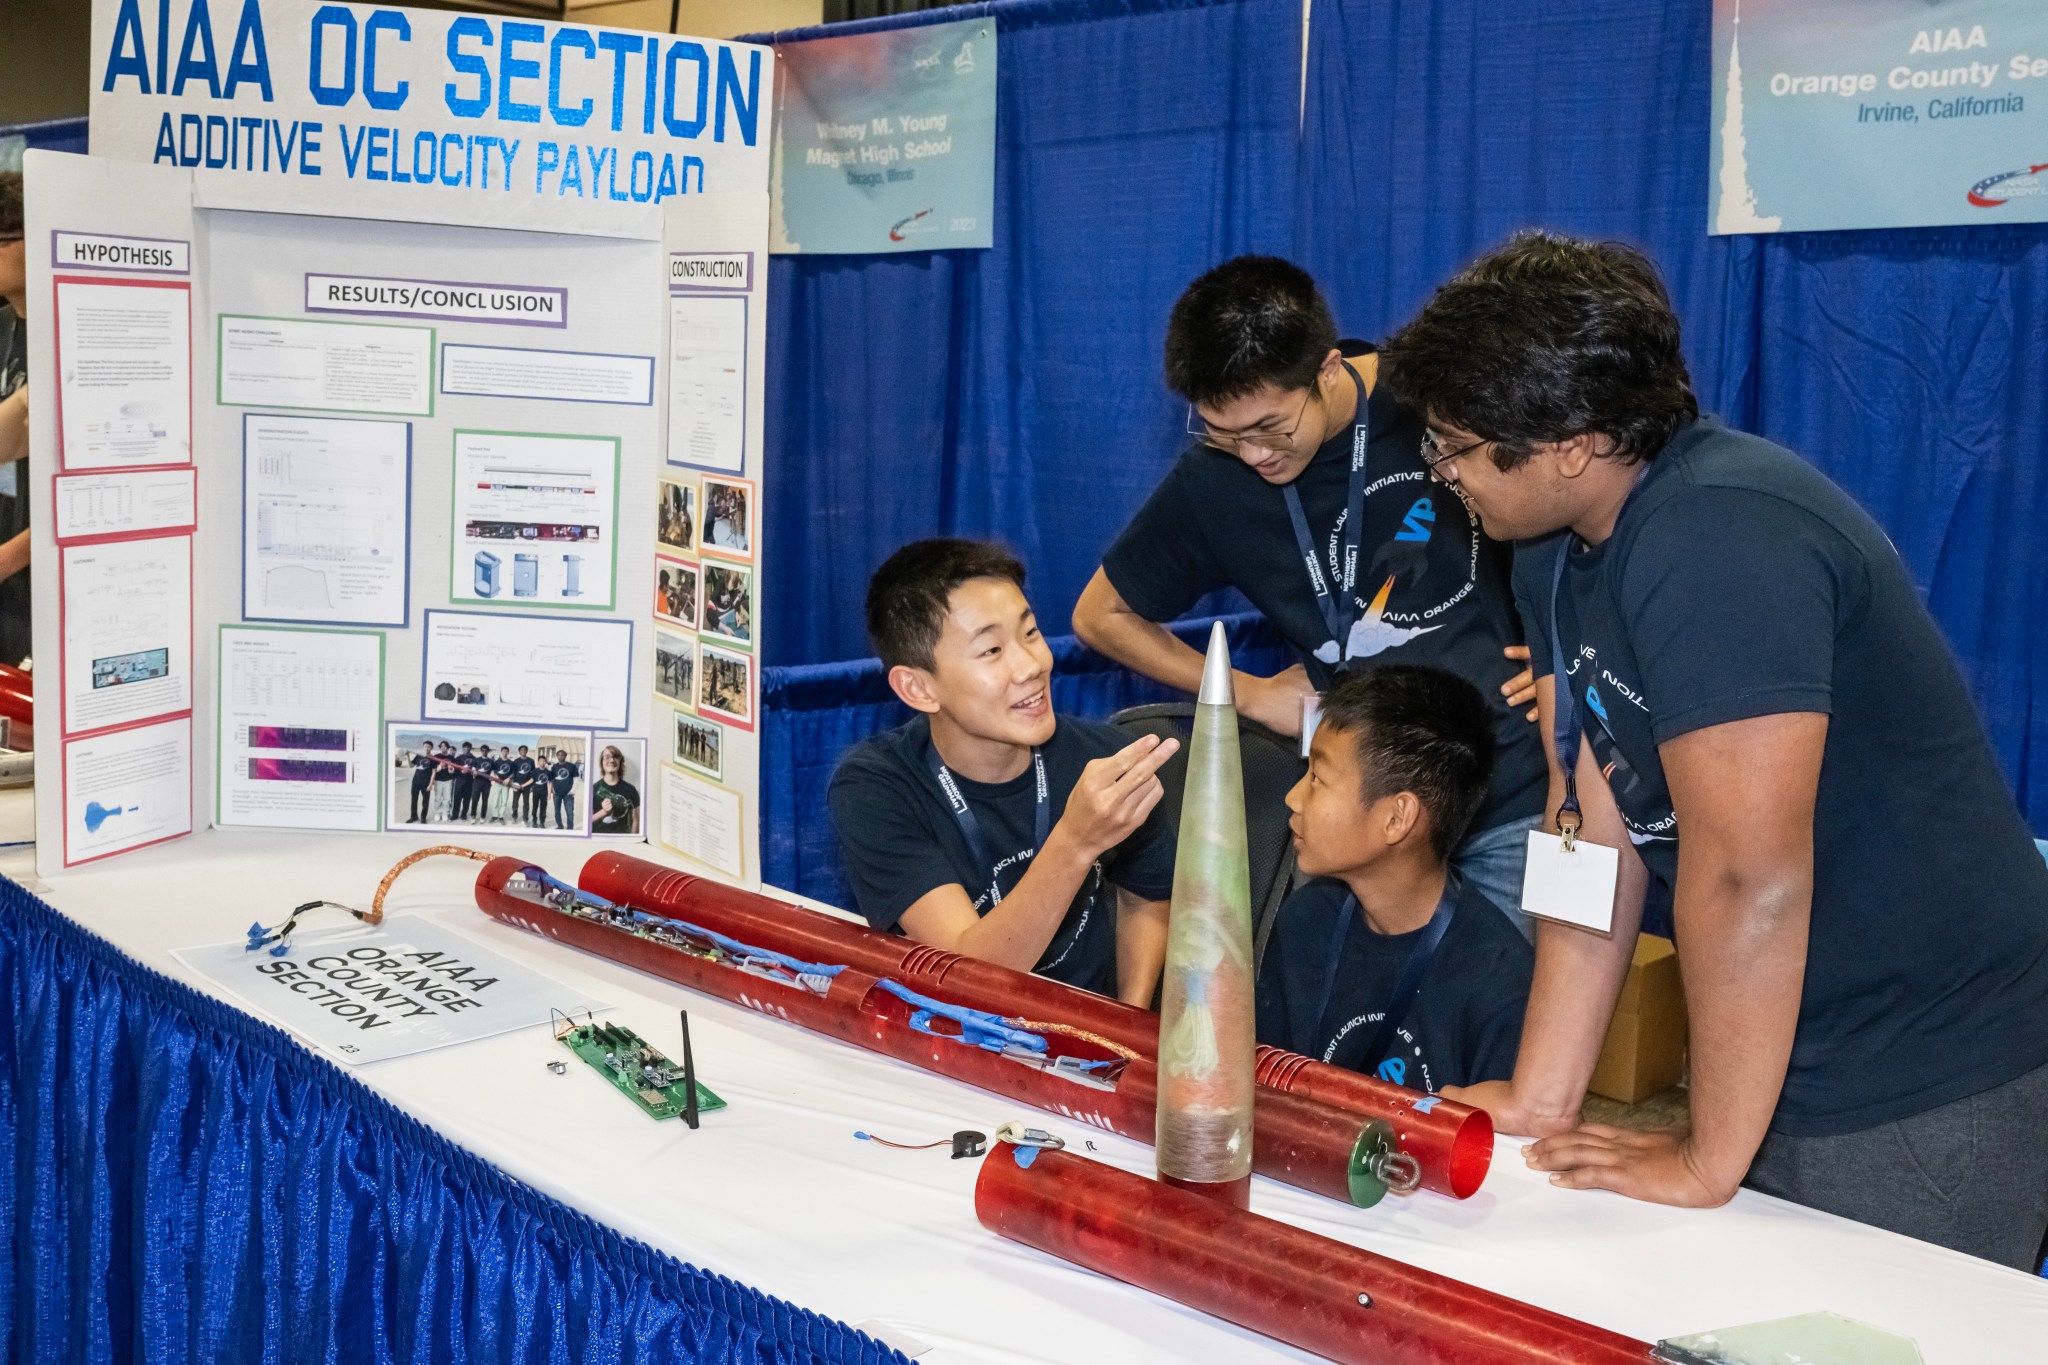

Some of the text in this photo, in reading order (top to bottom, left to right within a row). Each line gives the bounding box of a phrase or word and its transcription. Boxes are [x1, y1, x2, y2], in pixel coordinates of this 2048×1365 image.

[1909, 25, 1986, 54] AIAA
[102, 0, 761, 146] AIAA OC SECTION
[1770, 73, 1877, 96] Orange
[1888, 61, 1999, 91] County
[871, 117, 893, 135] M.
[899, 114, 947, 133] Young
[1858, 93, 2024, 123] Irvine, California
[153, 112, 705, 204] ADDITIVE VELOCITY PAYLOAD
[860, 144, 900, 165] High
[904, 136, 951, 160] School
[74, 243, 173, 266] HYPOTHESIS
[672, 261, 743, 278] CONSTRUCTION
[1352, 435, 1360, 471] NORTHROP
[1358, 430, 1366, 467] GRUMMAN
[1328, 533, 1343, 582] STUDENT
[1363, 471, 1425, 496] INITIATIVE
[1305, 556, 1321, 591] GRUMMAN
[1309, 549, 1325, 585] NORTHROP
[1349, 550, 1357, 587] GRUMMAN
[1424, 582, 1474, 619] ORANGE
[1471, 530, 1480, 581] COUNTY
[938, 773, 960, 809] GRUMMAN
[940, 765, 963, 801] NORTHROP
[1039, 759, 1048, 798] GRUMMAN
[307, 957, 438, 1018] COUNTY
[347, 948, 485, 1013] ORANGE
[402, 952, 498, 992] AIAA
[256, 961, 392, 1030] SECTION
[1336, 1014, 1366, 1040] LAUNCH
